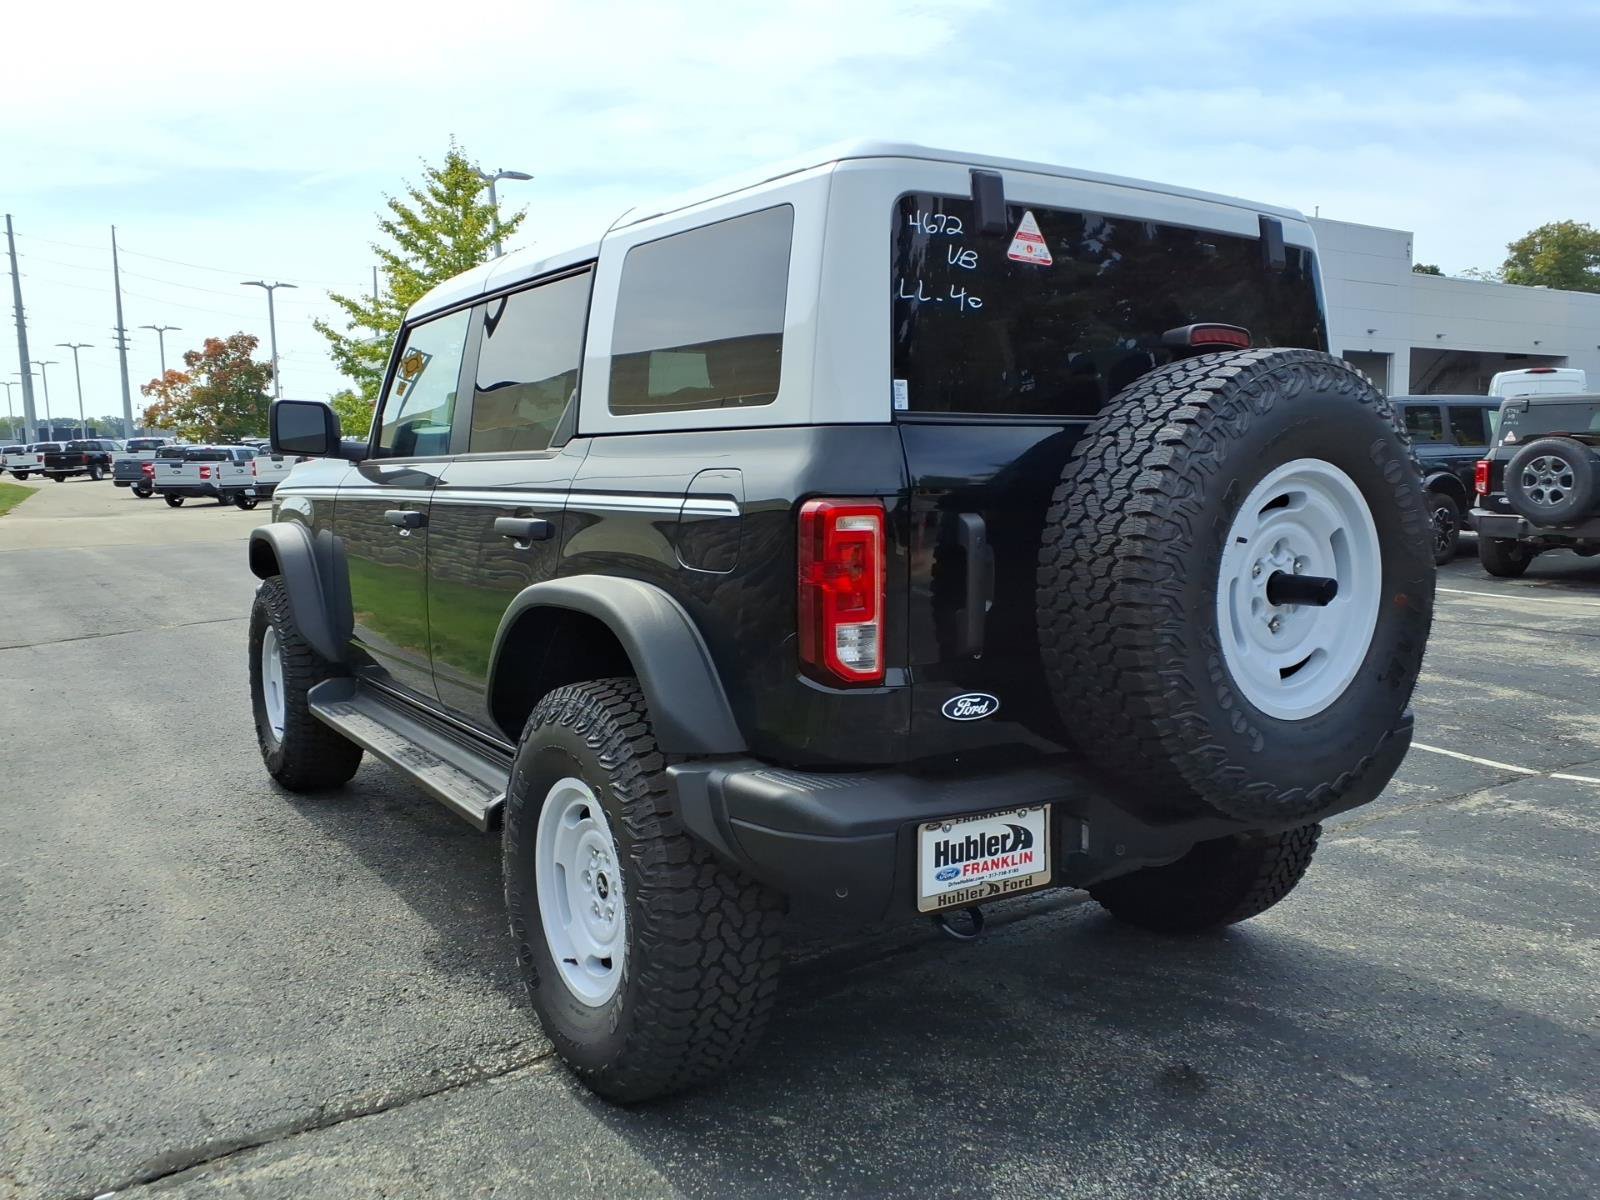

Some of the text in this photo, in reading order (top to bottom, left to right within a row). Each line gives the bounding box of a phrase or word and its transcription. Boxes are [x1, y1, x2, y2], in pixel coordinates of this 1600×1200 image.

[909, 210, 963, 235] 4672
[953, 697, 990, 717] Ford
[934, 832, 1010, 868] Hubler
[962, 850, 1034, 877] FRANKLIN
[937, 875, 1034, 907] Hubler Ford
